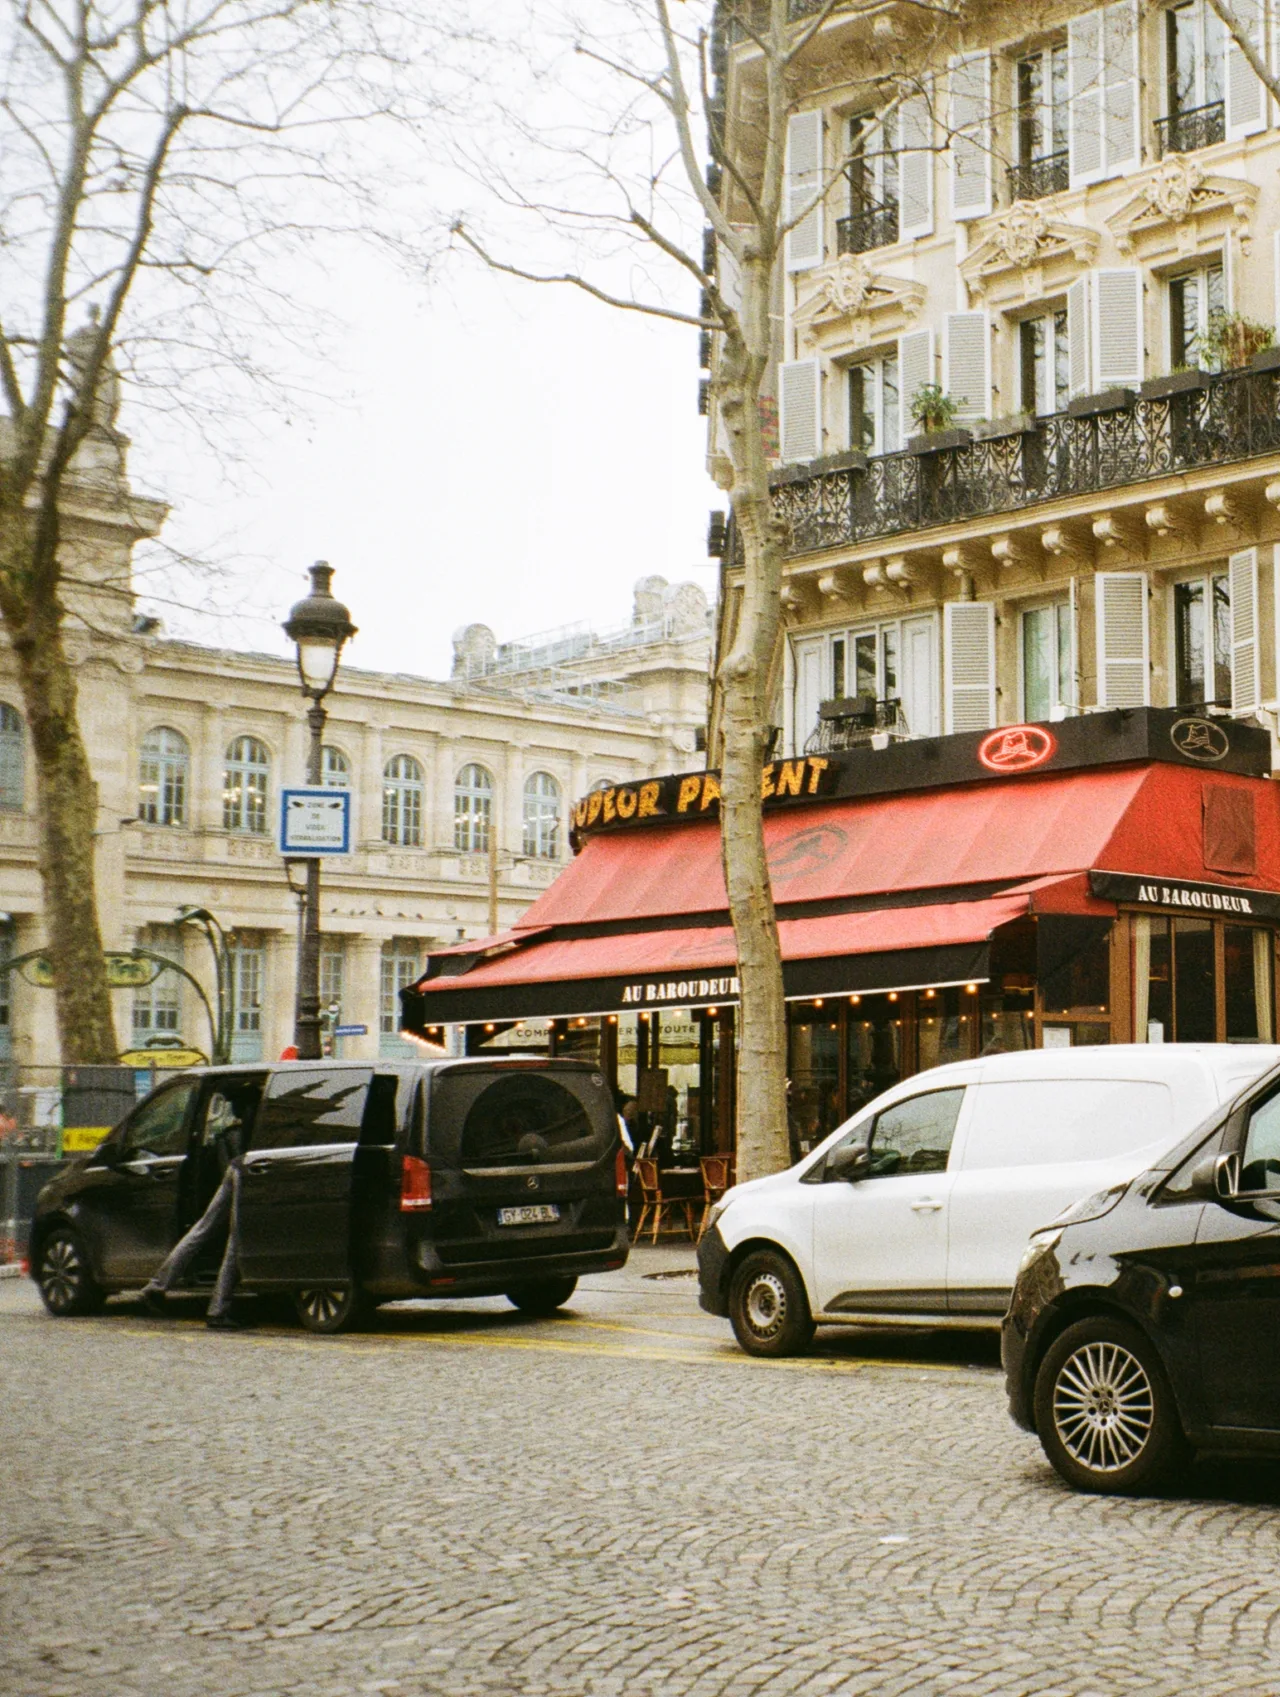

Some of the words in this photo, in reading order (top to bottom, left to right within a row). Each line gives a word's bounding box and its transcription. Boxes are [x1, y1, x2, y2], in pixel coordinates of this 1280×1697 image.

[677, 757, 829, 814] PAENT
[1138, 885, 1158, 902] AU
[1162, 887, 1252, 914] BAROUDEUR
[622, 985, 643, 1002] AU
[645, 977, 740, 1001] BAROUDEUR
